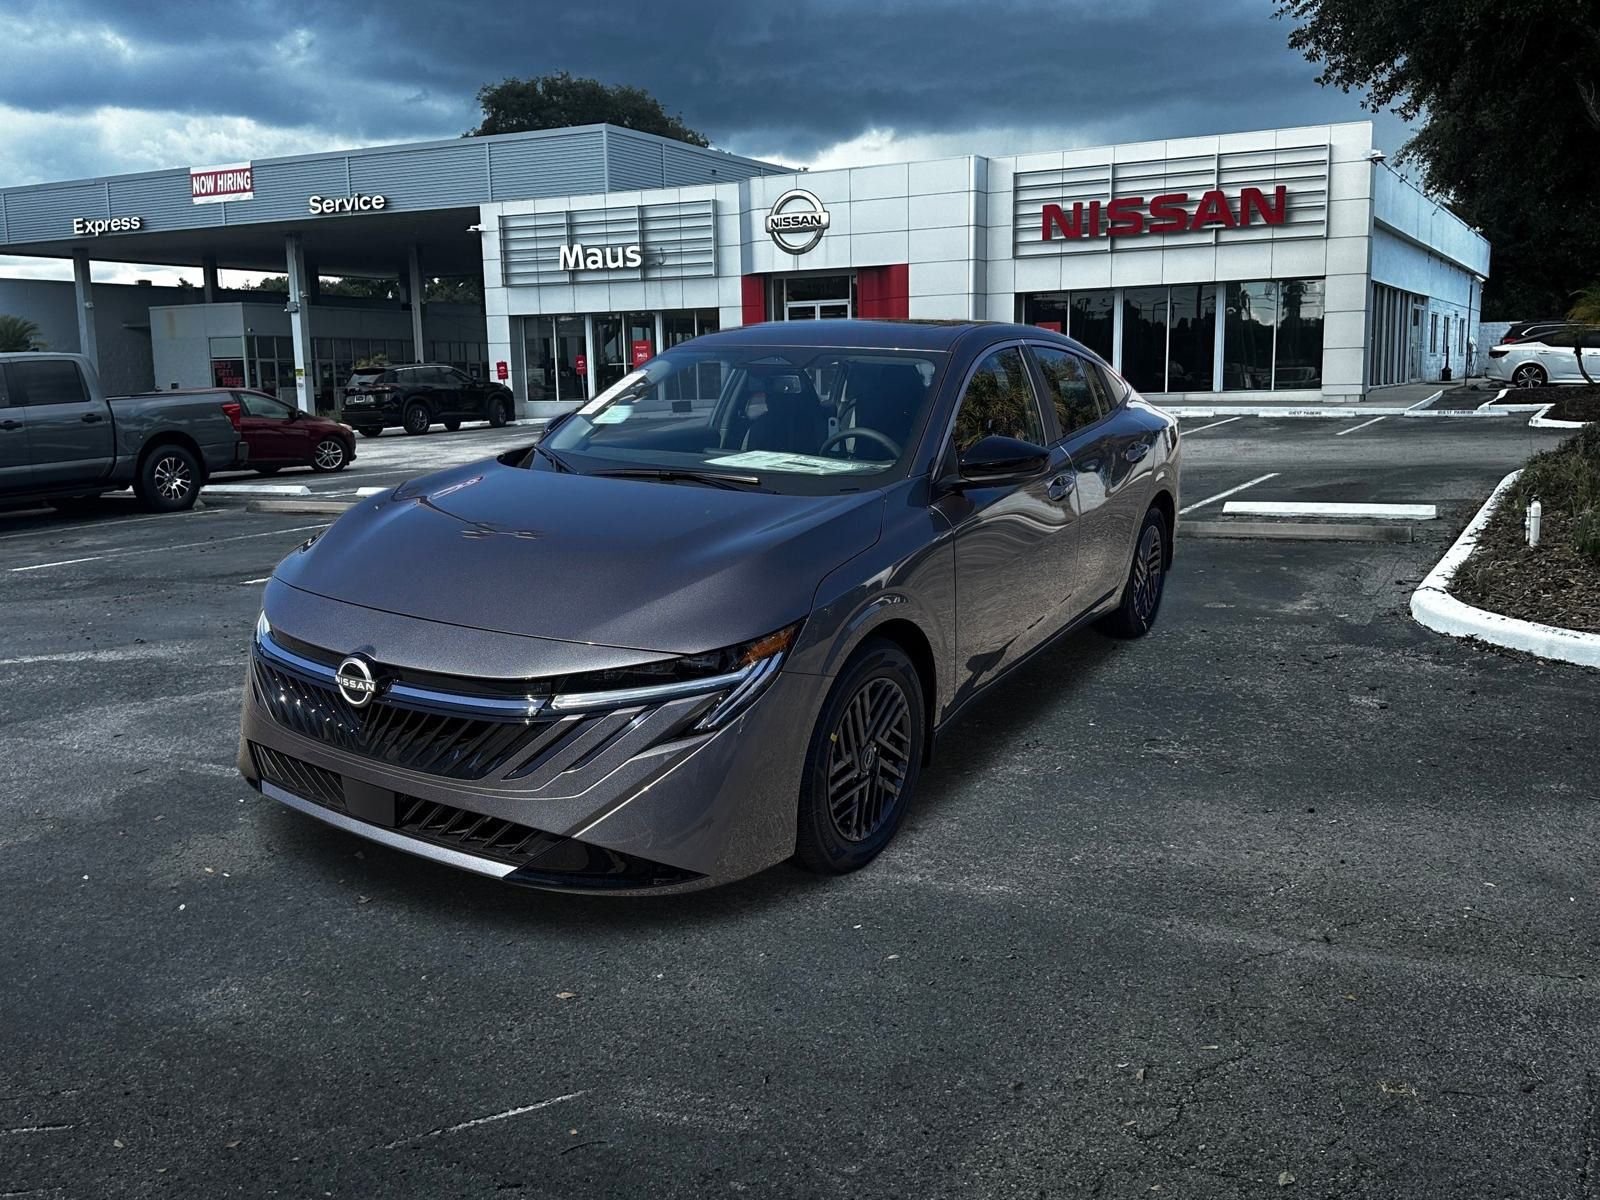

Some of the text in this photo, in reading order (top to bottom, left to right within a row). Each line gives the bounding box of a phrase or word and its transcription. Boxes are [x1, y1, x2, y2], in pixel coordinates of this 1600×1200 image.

[192, 171, 251, 195] NOW HIRING
[309, 193, 385, 214] Service
[1042, 185, 1287, 241] NISSAN
[73, 216, 141, 236] Express
[770, 215, 822, 228] NISSAN
[560, 244, 641, 270] Maus
[335, 674, 375, 692] NISSAN
